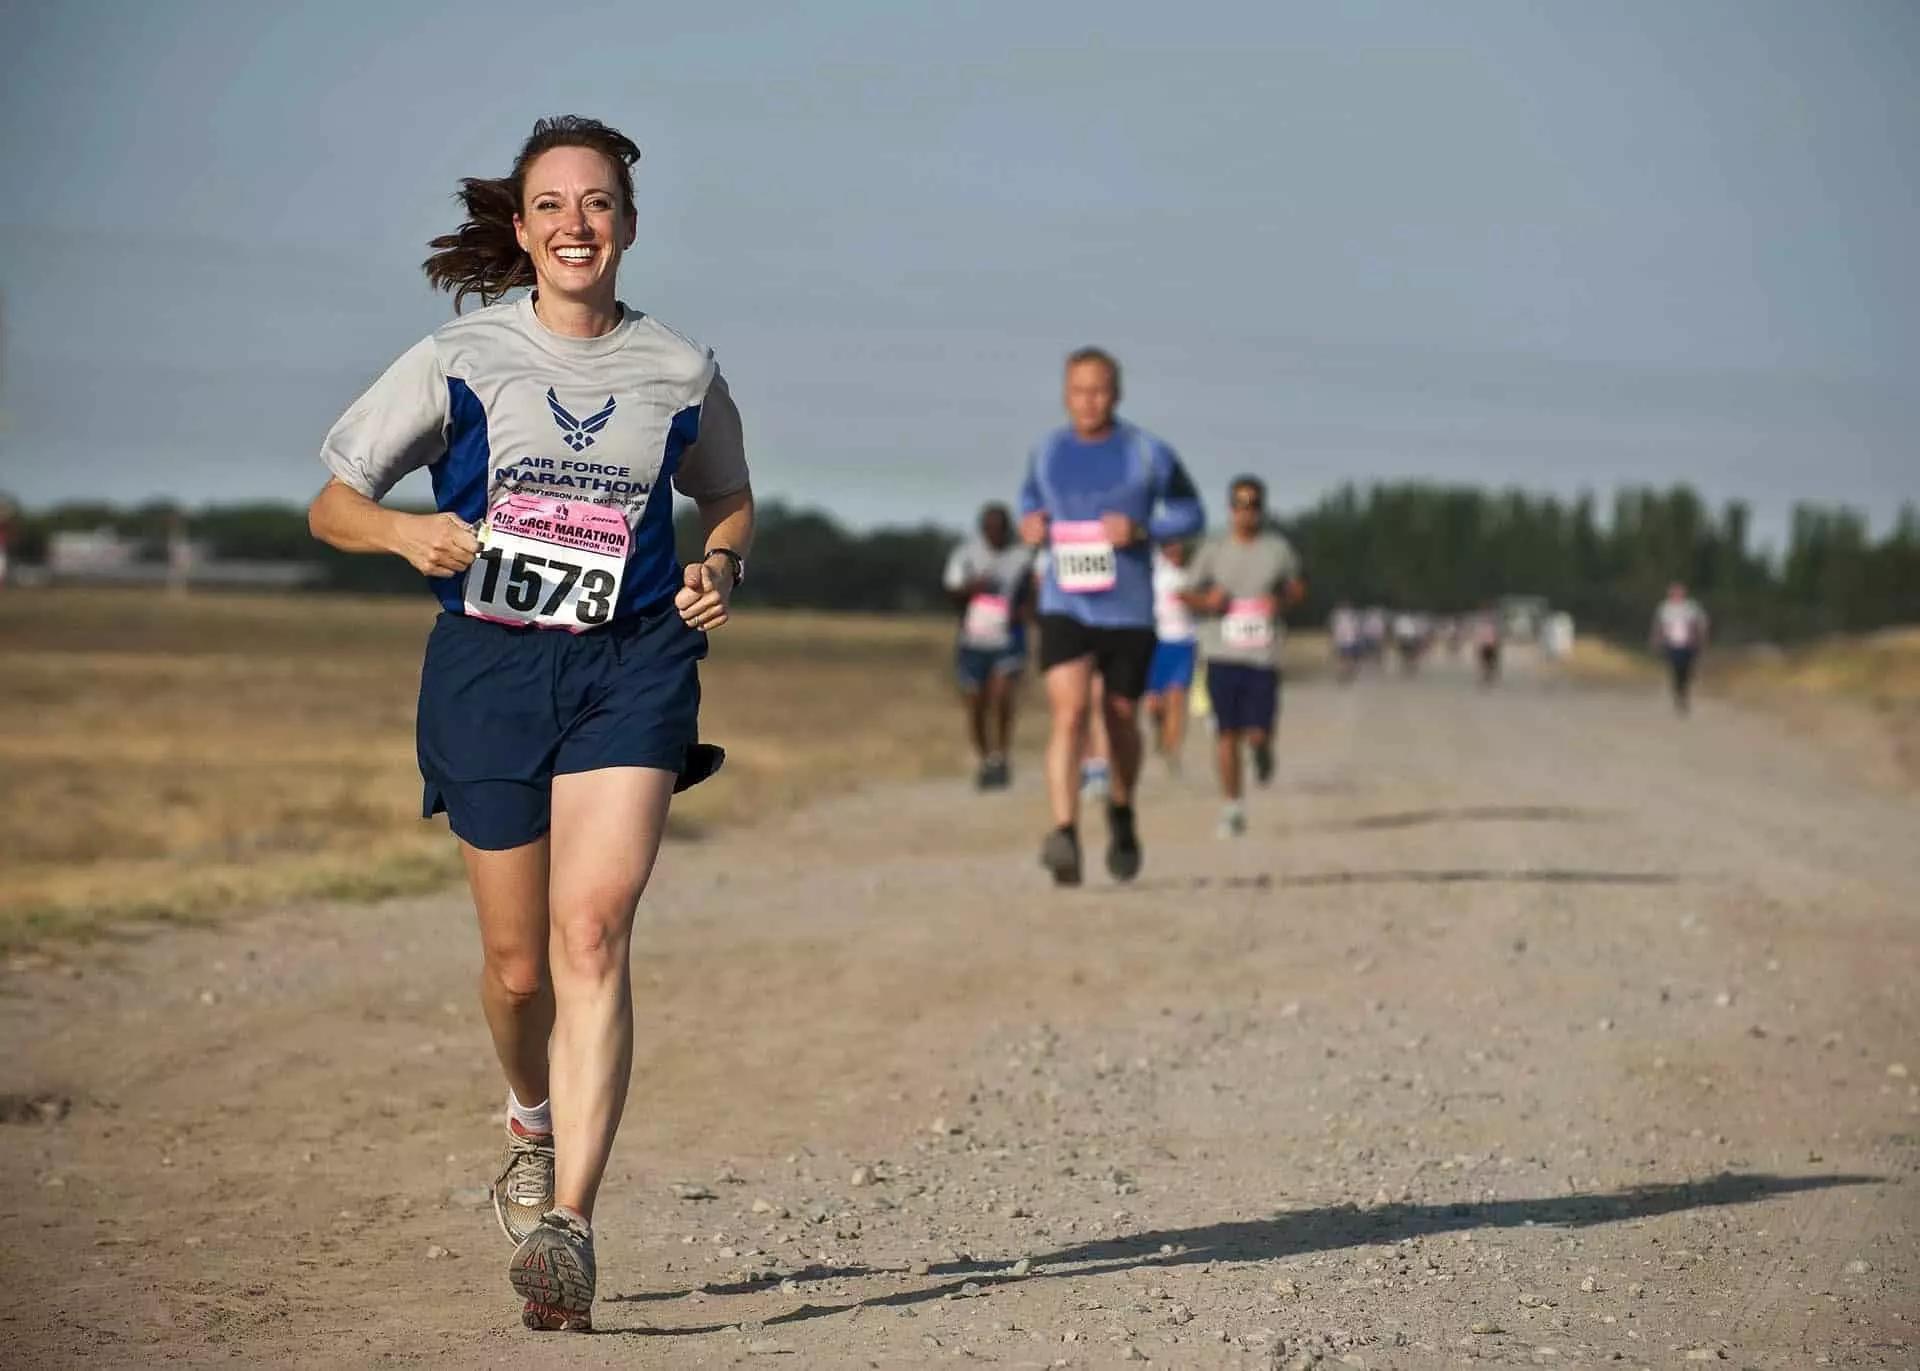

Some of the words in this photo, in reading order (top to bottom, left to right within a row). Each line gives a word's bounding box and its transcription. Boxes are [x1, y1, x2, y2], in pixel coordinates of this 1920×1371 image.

[520, 456, 554, 470] AIR
[561, 461, 631, 478] FORCE
[495, 468, 650, 494] MARATHON
[493, 524, 530, 535] MATHON
[536, 530, 557, 540] HALF
[558, 535, 601, 550] MARATHON
[518, 517, 553, 532] ORCE
[554, 523, 626, 547] MARATHON
[479, 547, 616, 625] 1573
